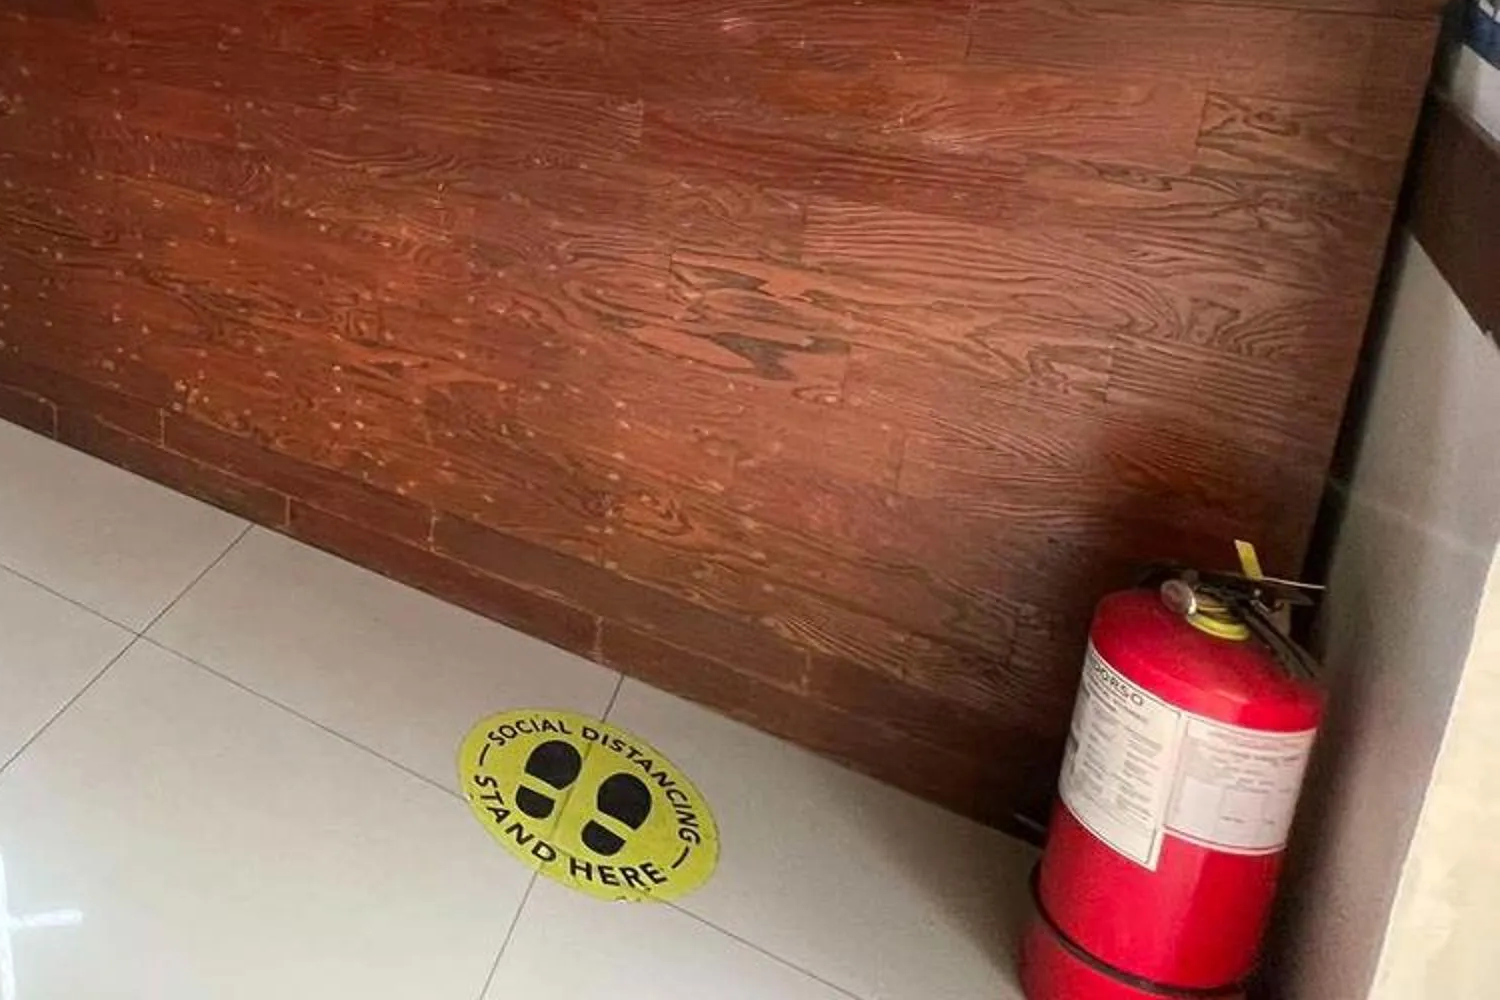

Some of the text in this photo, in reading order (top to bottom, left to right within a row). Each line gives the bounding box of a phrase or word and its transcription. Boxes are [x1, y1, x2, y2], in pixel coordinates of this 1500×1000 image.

[474, 774, 669, 890] STAND HERE
[487, 719, 701, 846] SOCIAL DISTANCING
